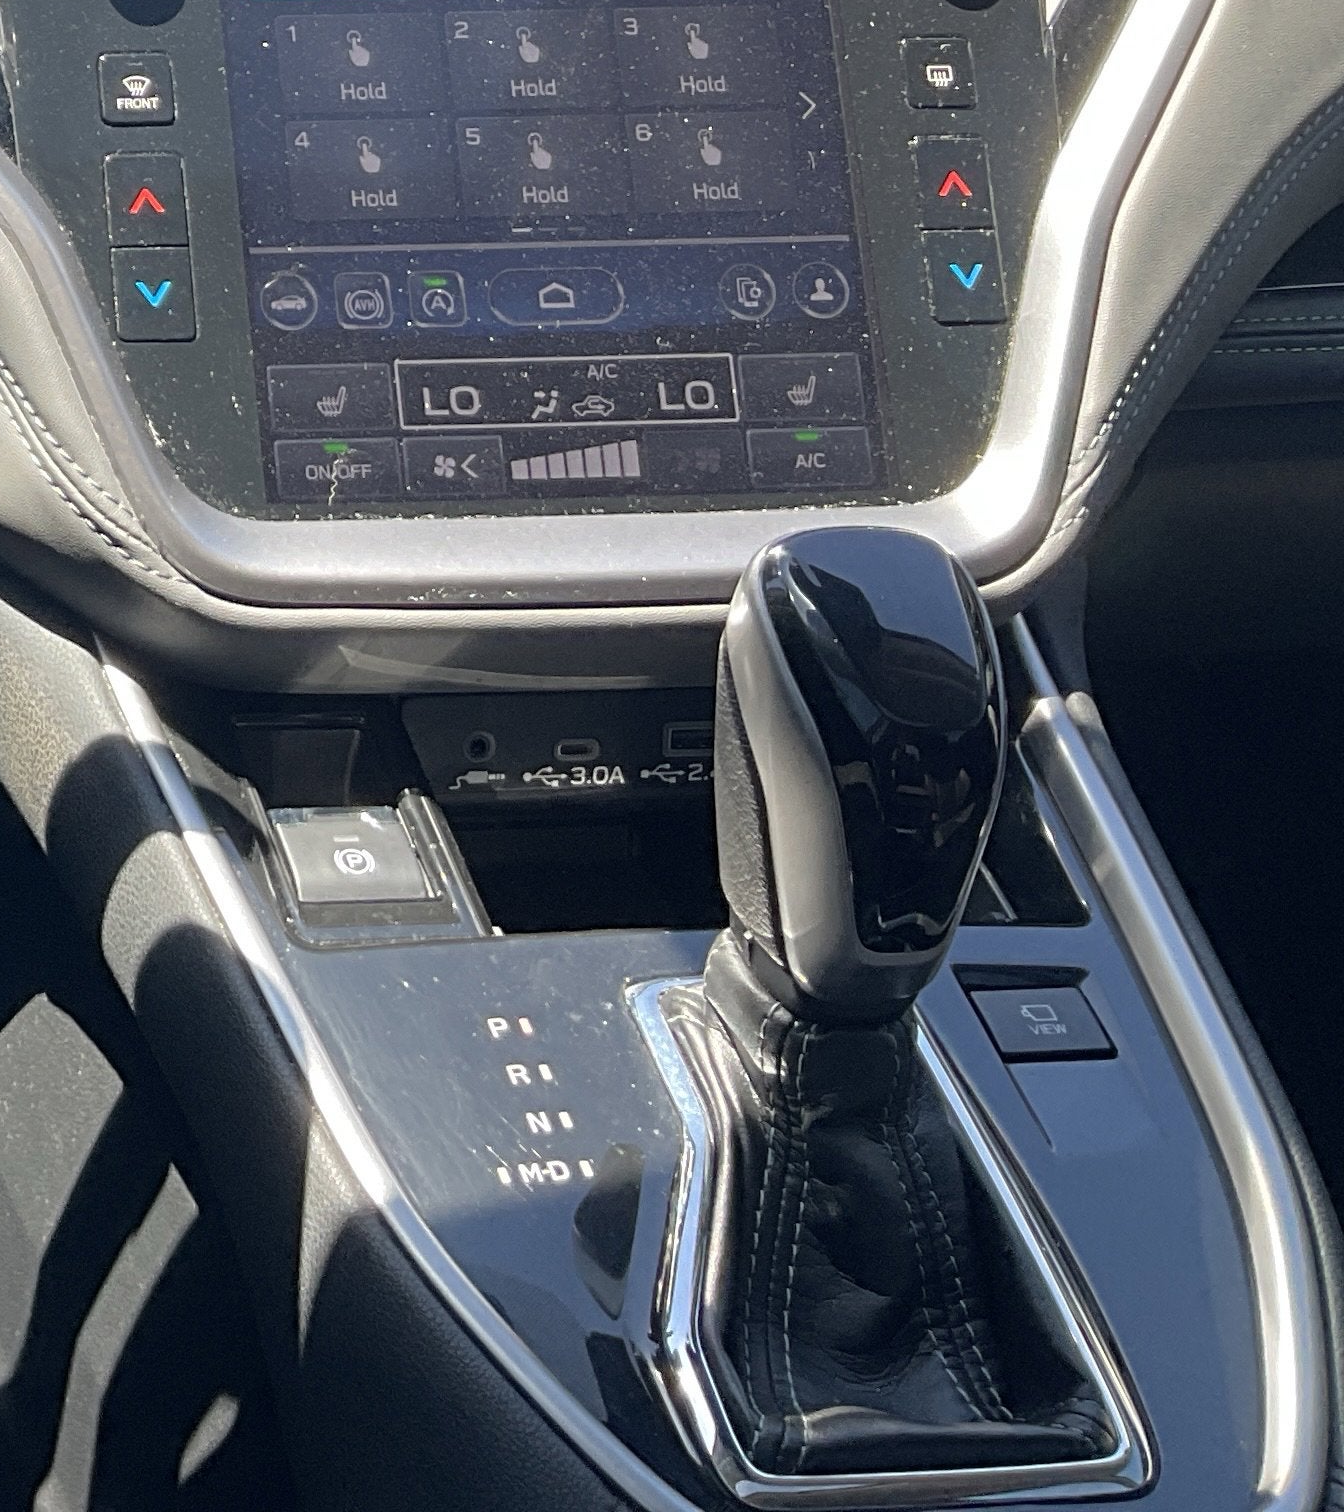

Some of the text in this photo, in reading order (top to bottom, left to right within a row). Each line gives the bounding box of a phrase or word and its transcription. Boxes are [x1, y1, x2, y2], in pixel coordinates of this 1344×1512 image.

[286, 25, 297, 43] 1
[453, 21, 470, 39] 2
[622, 17, 639, 36] 3
[340, 82, 387, 100] Hold
[510, 78, 557, 97] Hold
[679, 75, 727, 93] Hold
[115, 97, 159, 110] FRONT
[294, 131, 310, 148] 4
[465, 127, 481, 146] 5
[635, 123, 650, 141] 6
[350, 189, 398, 207] Hold
[522, 184, 569, 203] Hold
[692, 181, 740, 200] Hold
[587, 363, 619, 379] A/C
[422, 385, 481, 416] LO
[657, 380, 716, 411] LO
[795, 452, 827, 469] A/C
[304, 463, 372, 481] ON/OFF
[569, 765, 626, 786] 3.0A
[487, 1017, 508, 1038] P
[1027, 1023, 1068, 1036] VIEW
[505, 1063, 532, 1086] R
[525, 1111, 552, 1134] N
